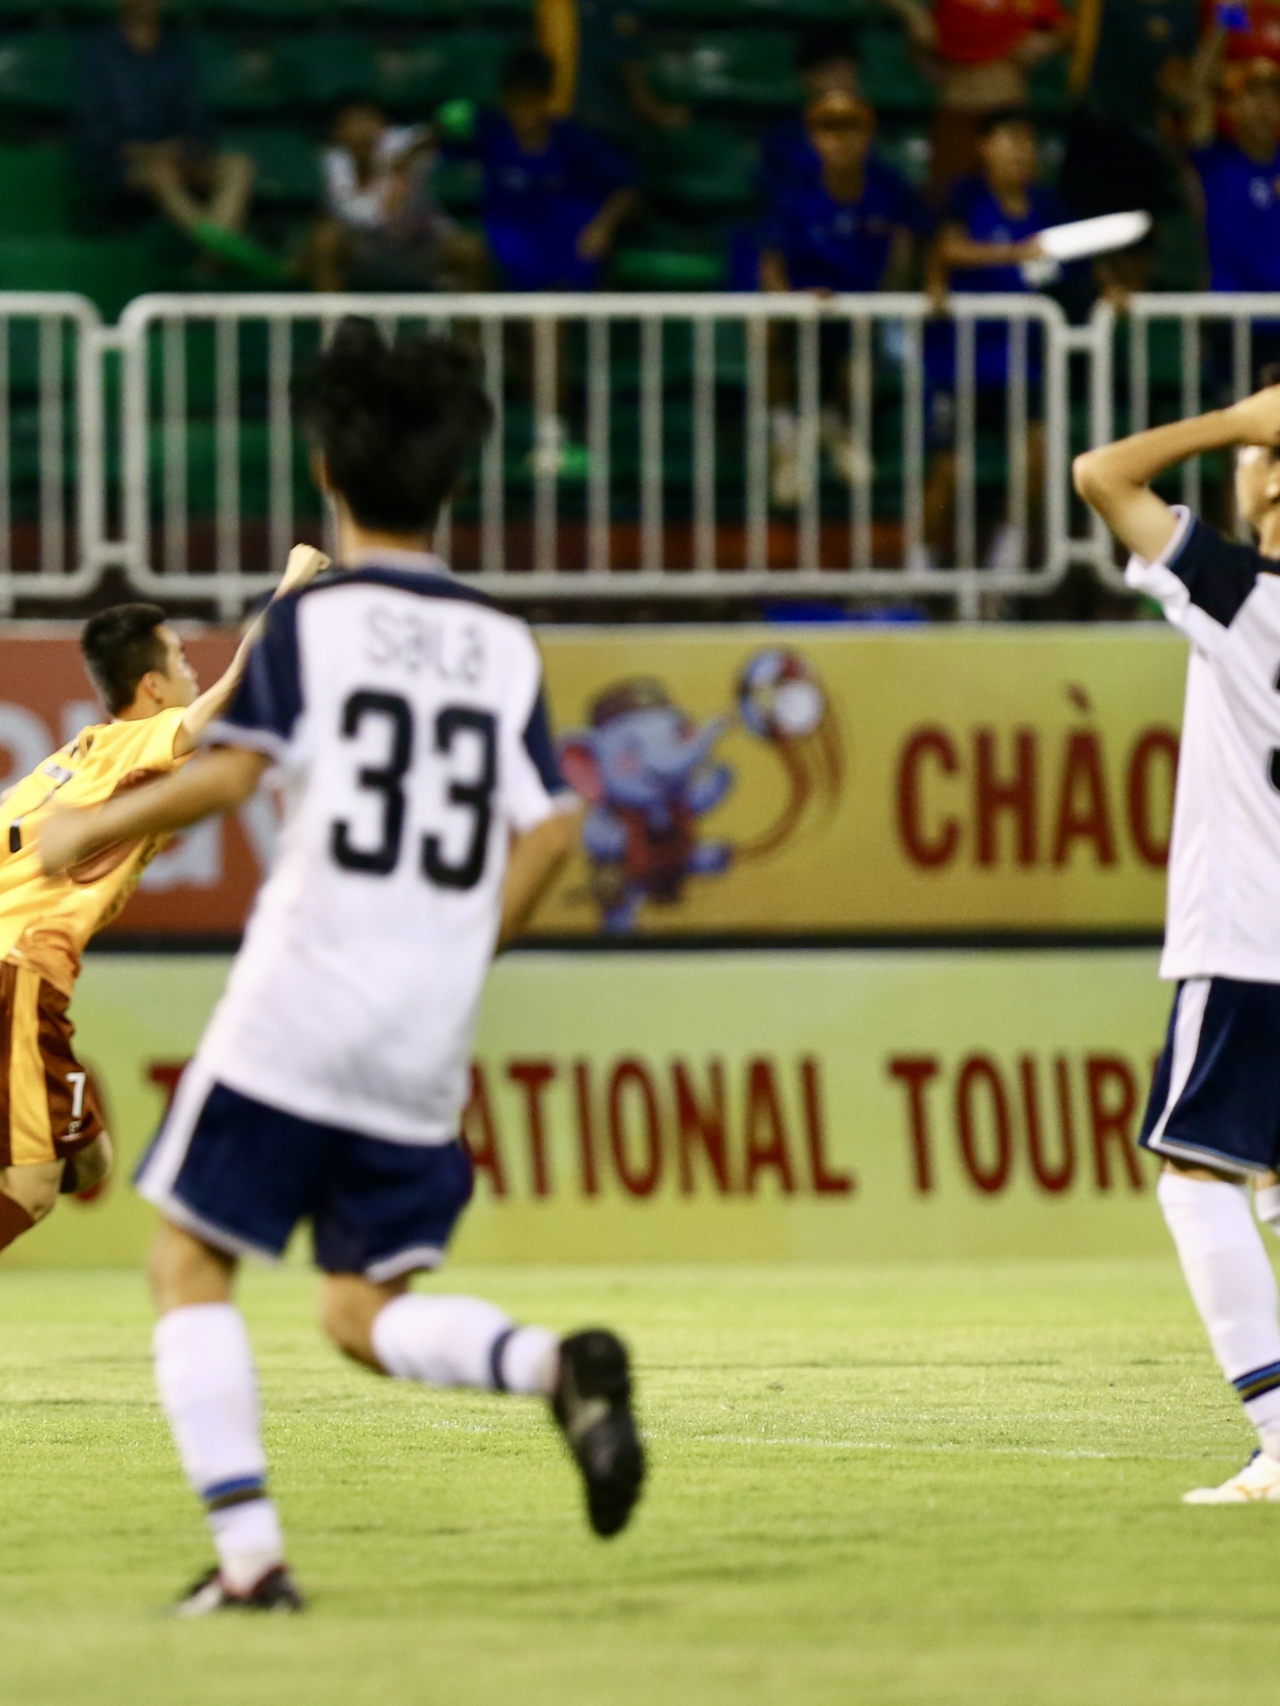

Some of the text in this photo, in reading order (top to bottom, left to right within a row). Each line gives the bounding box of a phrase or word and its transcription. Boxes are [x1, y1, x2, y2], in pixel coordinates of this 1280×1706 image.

[331, 687, 499, 892] 33
[894, 682, 1182, 870] CHÀO
[66, 1071, 86, 1118] 7
[461, 1058, 854, 1197] ATIONAL
[888, 1055, 1157, 1193] TOUR
